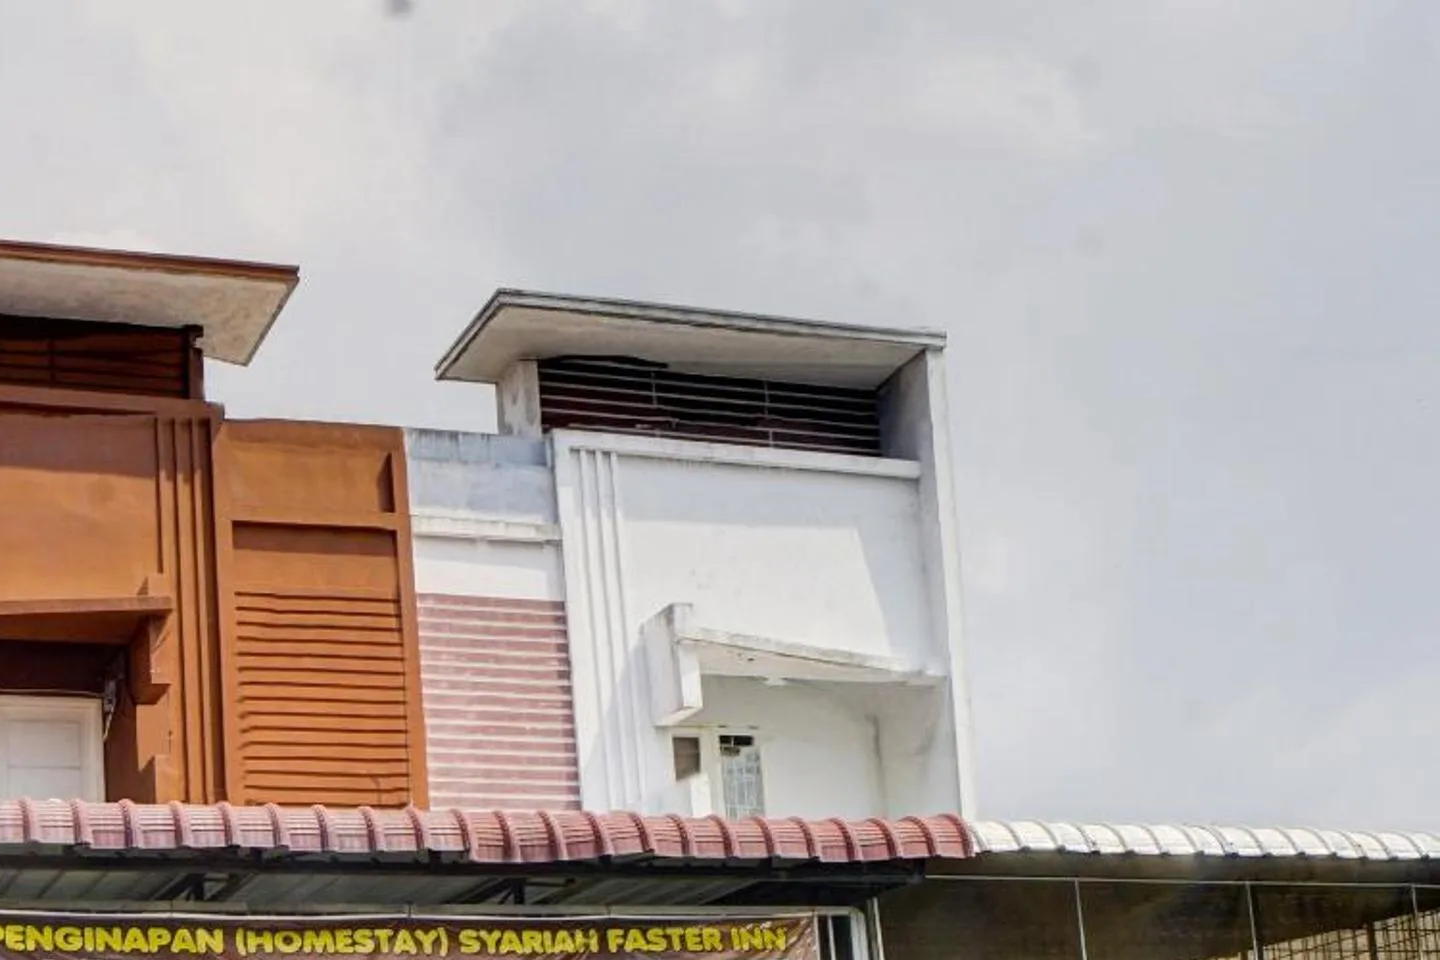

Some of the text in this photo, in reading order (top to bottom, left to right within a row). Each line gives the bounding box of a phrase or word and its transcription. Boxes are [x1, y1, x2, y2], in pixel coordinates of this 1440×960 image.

[235, 926, 448, 957] (HOMESTAY)
[458, 927, 599, 953] SYARIAH
[607, 927, 724, 953] FASTER
[730, 926, 787, 951] INN
